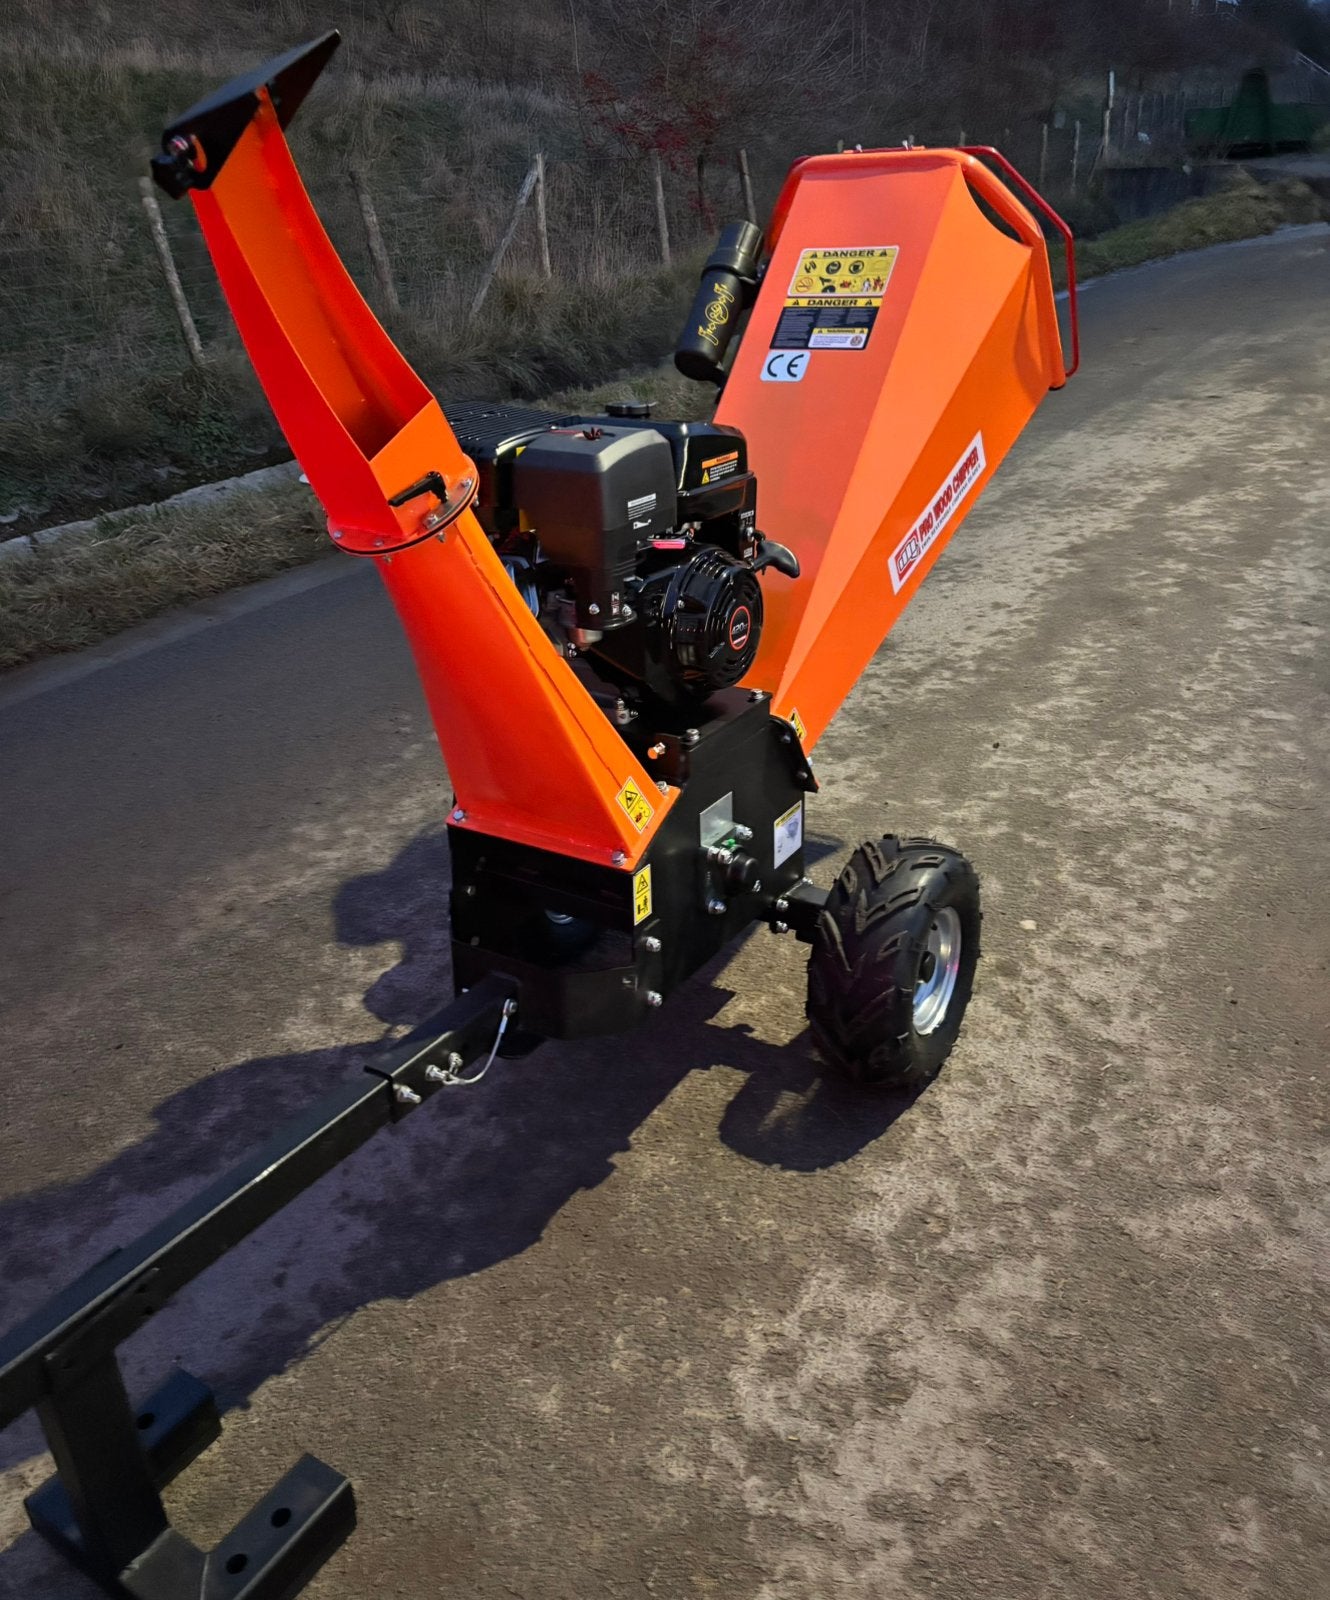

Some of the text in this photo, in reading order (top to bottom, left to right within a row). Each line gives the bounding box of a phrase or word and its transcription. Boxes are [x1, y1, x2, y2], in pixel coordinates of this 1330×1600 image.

[822, 250, 875, 258] DANGER
[767, 354, 804, 378] CE
[918, 446, 979, 542] PRO WOOD CHIPPER
